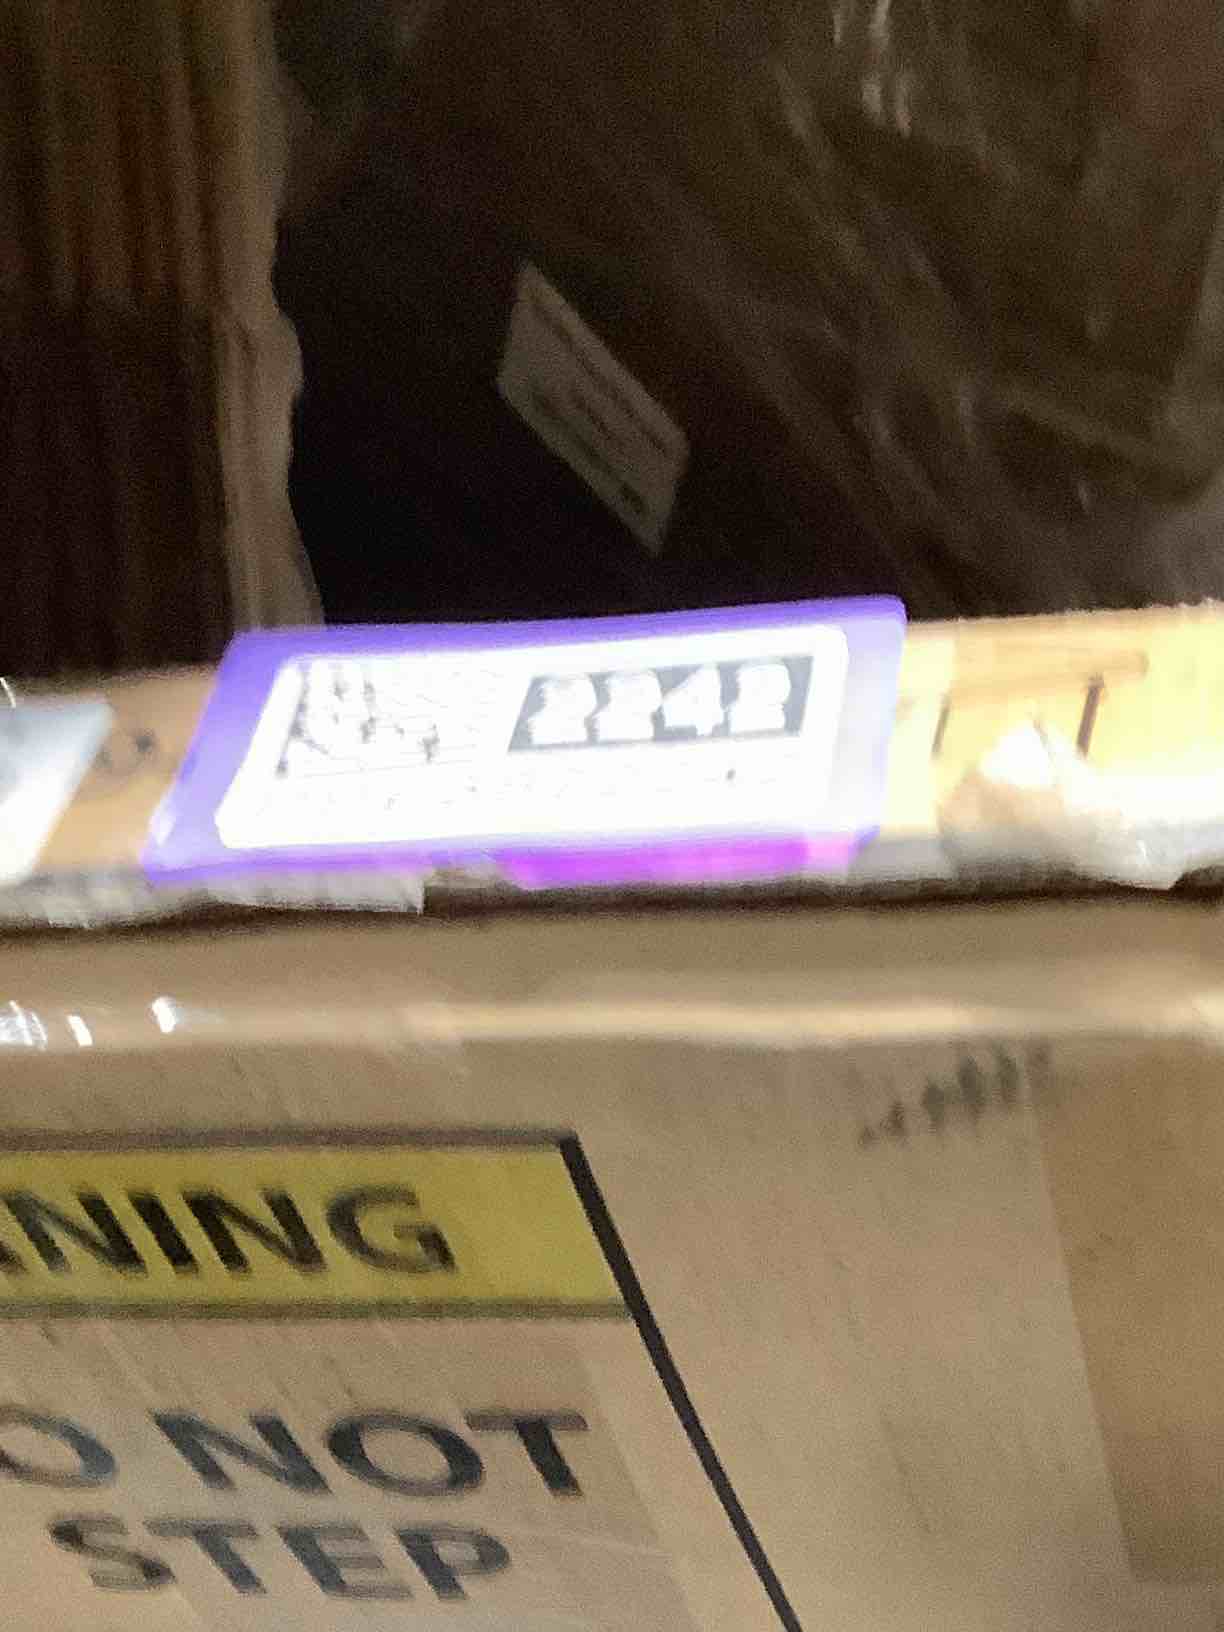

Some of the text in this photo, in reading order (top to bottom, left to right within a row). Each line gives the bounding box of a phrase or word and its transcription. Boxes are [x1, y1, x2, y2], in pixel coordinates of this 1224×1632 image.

[0, 1185, 458, 1274] NING
[148, 1407, 588, 1498] NOT
[47, 1513, 511, 1602] STEP
